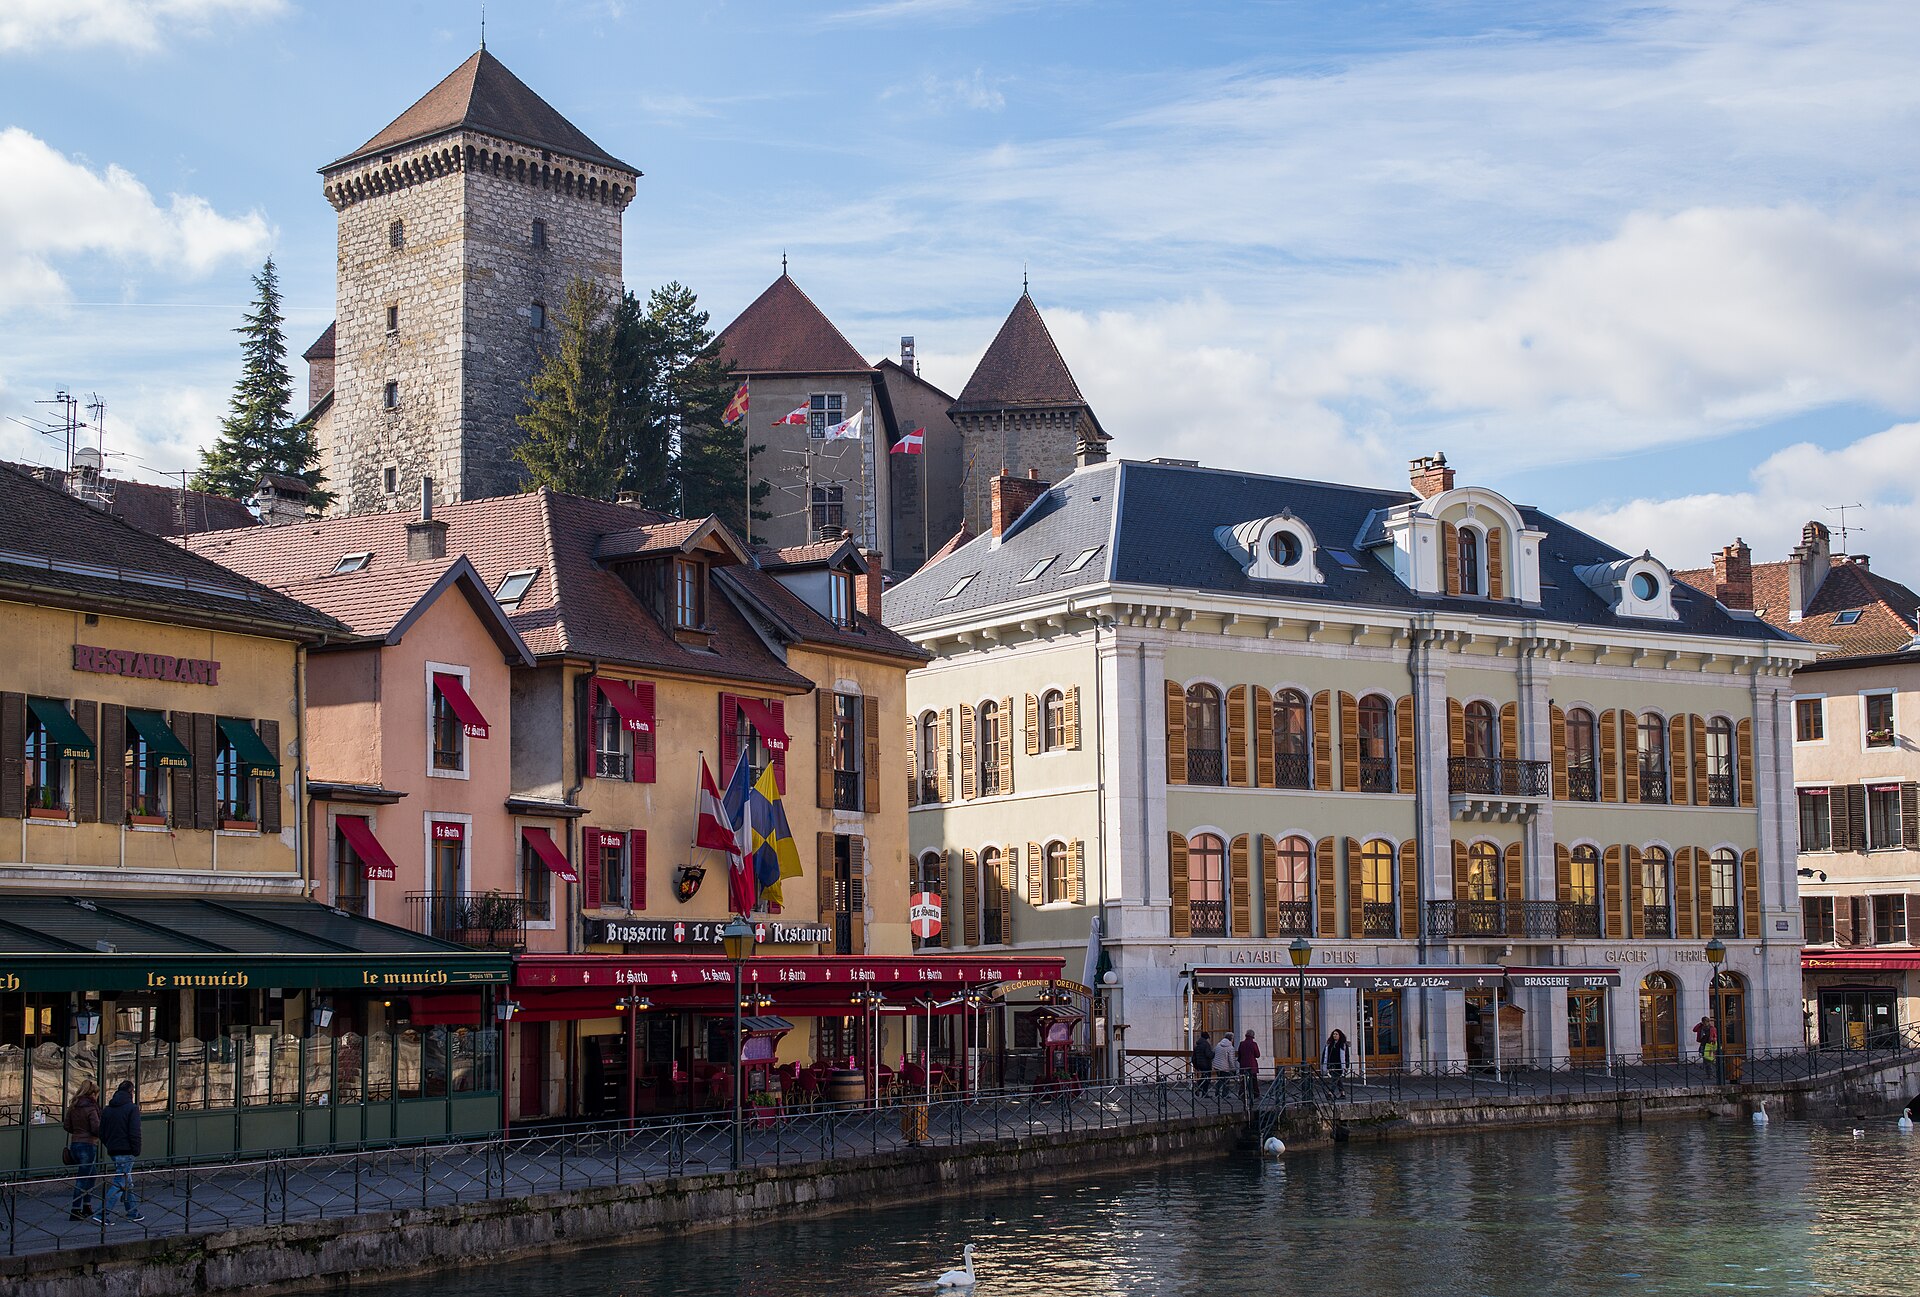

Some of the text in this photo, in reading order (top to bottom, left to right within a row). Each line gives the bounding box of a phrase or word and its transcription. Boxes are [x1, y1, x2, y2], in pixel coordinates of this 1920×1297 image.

[73, 644, 221, 686] RESTAURANT
[63, 748, 91, 760] Munich
[159, 756, 188, 768] Munich
[250, 768, 276, 779] Munich
[911, 906, 940, 919] Le Sarto
[606, 922, 667, 943] Brasserie
[692, 923, 710, 941] Le
[770, 922, 832, 943] Restaurant
[1230, 951, 1246, 964] LA
[1247, 951, 1282, 964] TABLE
[1605, 950, 1709, 962] GLACIER PERRIE
[147, 971, 249, 988] le munich
[363, 969, 448, 985] le munich
[615, 969, 649, 984] Le Sarto
[700, 968, 731, 982] Le Sarto
[779, 968, 807, 981] Le Sarto
[849, 968, 876, 981] Le Sarto
[918, 968, 942, 980] Le Sarto
[979, 968, 1002, 980] Le Sarto
[1229, 977, 1282, 987] RESTAURANT
[1374, 977, 1450, 987] La Table d'Elise
[1524, 976, 1609, 986] BRASSERIE PIZZA
